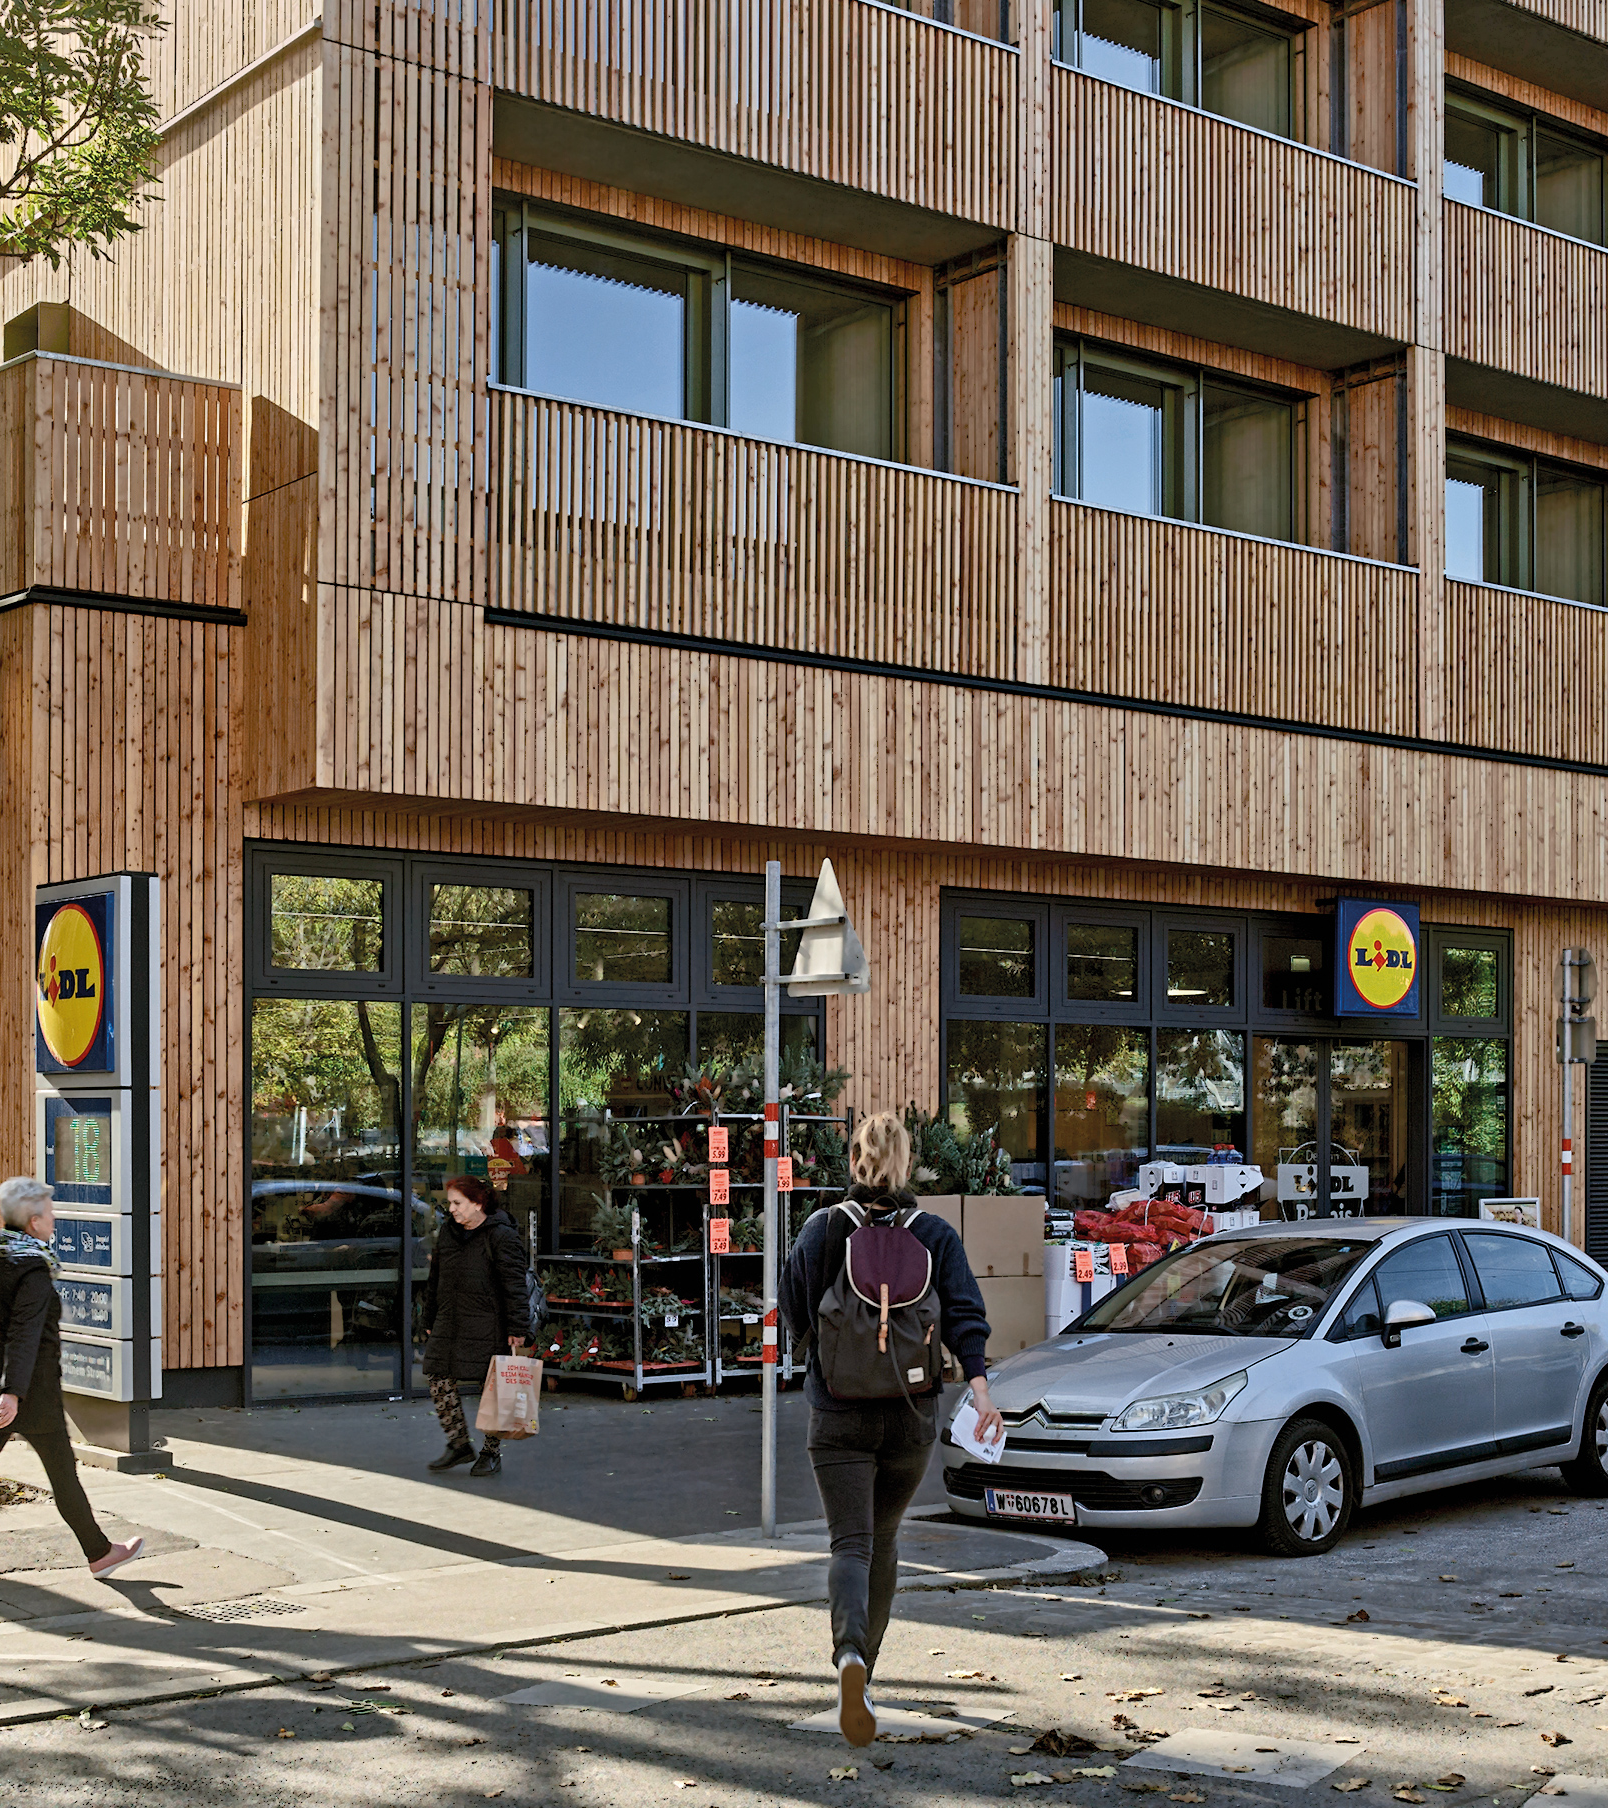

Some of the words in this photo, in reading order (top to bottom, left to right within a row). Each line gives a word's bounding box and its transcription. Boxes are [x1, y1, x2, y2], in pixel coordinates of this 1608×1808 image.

[1355, 940, 1412, 972] LIDL
[70, 1118, 100, 1183] 18
[1078, 1269, 1093, 1279] 2.49
[995, 1493, 1006, 1511] W
